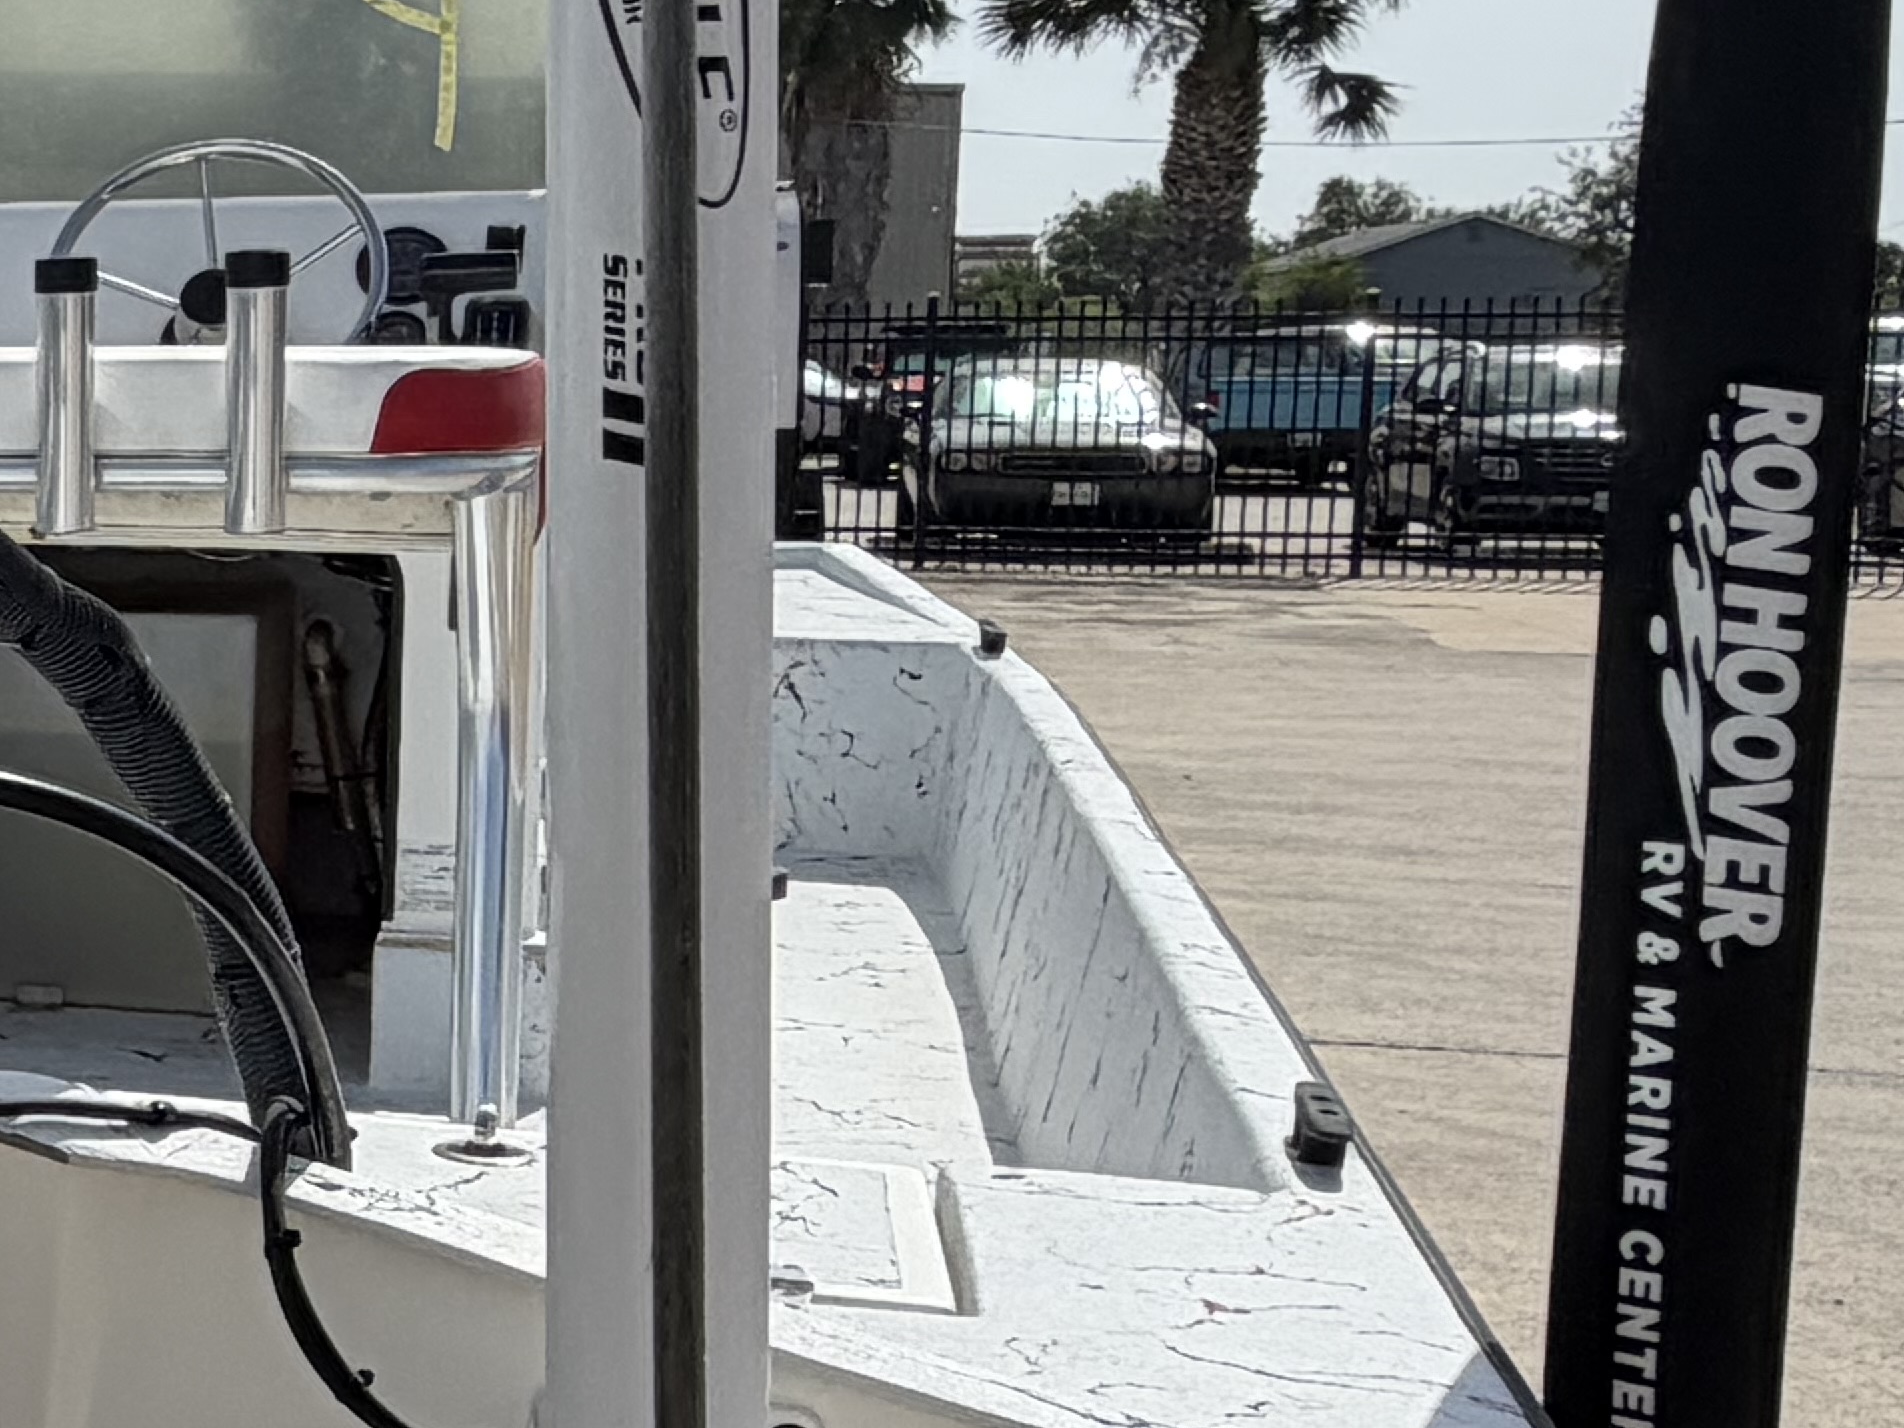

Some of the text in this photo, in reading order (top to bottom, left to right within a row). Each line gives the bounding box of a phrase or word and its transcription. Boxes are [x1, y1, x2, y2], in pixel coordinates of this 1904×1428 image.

[603, 252, 628, 382] SERIES
[1698, 383, 1824, 954] RON HOOVER
[1639, 840, 1684, 919] RV
[1637, 933, 1680, 964] &
[1621, 985, 1678, 1211] MARINE
